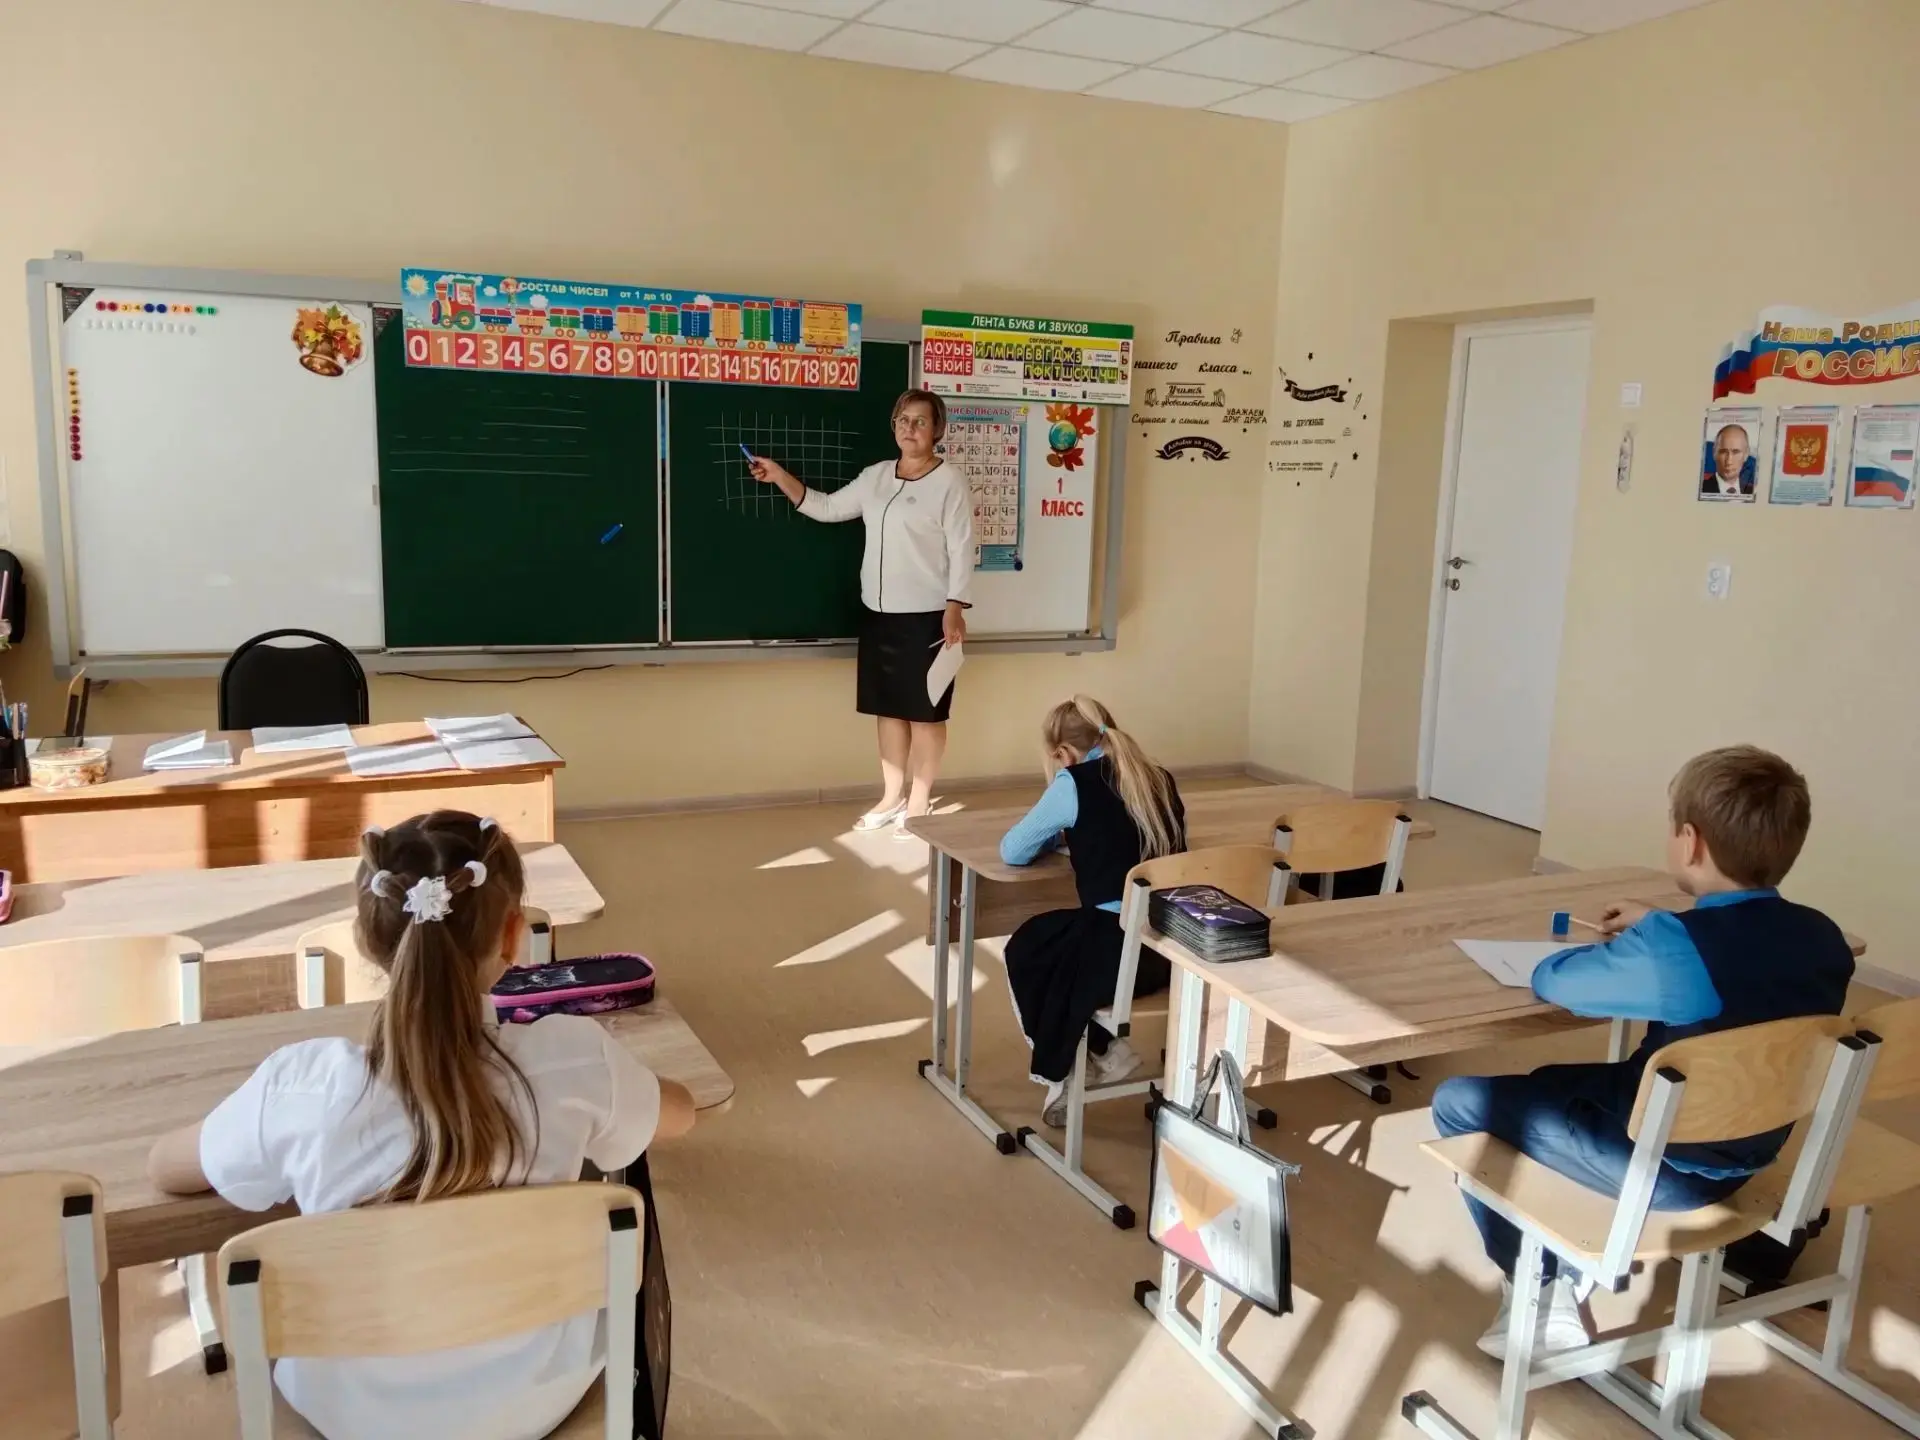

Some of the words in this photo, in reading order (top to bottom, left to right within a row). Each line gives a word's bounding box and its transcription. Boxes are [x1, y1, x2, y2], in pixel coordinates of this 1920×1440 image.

[519, 282, 567, 294] СОСТАВ
[570, 286, 608, 297] ЧИСЕЛ
[634, 291, 640, 299] 1
[644, 294, 657, 302] до
[660, 292, 672, 302] 10
[971, 316, 1005, 328] ЛЕНТА
[1008, 318, 1035, 330] БУКВ
[1038, 320, 1046, 331] И
[1050, 321, 1088, 334] ЗВУКОВ
[1760, 320, 1833, 344] Наша
[1165, 330, 1222, 348] Правила
[409, 336, 428, 362] 0
[437, 337, 448, 363] 1
[458, 338, 476, 364] 2
[482, 340, 499, 366] 3
[504, 341, 524, 367] 4
[528, 343, 546, 368] 5
[550, 344, 569, 370] 6
[572, 346, 590, 371] 7
[595, 346, 612, 372] 8
[617, 348, 634, 374] 9
[637, 350, 658, 375] 10
[660, 350, 678, 376] 11
[680, 352, 700, 377] 12
[701, 353, 720, 378] 13
[722, 355, 740, 380] 14
[743, 356, 761, 380] 15
[762, 357, 780, 382] 16
[782, 358, 800, 382] 17
[802, 360, 820, 384] 18
[822, 361, 839, 385] 19
[840, 362, 858, 386] 20
[1134, 360, 1178, 371] нашего
[1198, 362, 1238, 374] класса
[1772, 342, 1920, 380] РОССИЯ
[1168, 386, 1202, 398] Учимся
[947, 407, 971, 416] ЧИСЬ
[1222, 416, 1240, 424] ДРУГ
[1243, 416, 1268, 424] ДРУГА
[1226, 408, 1264, 416] УВАЖАЕМ
[1058, 478, 1063, 494] 1
[1041, 499, 1084, 517] КЛАСС
